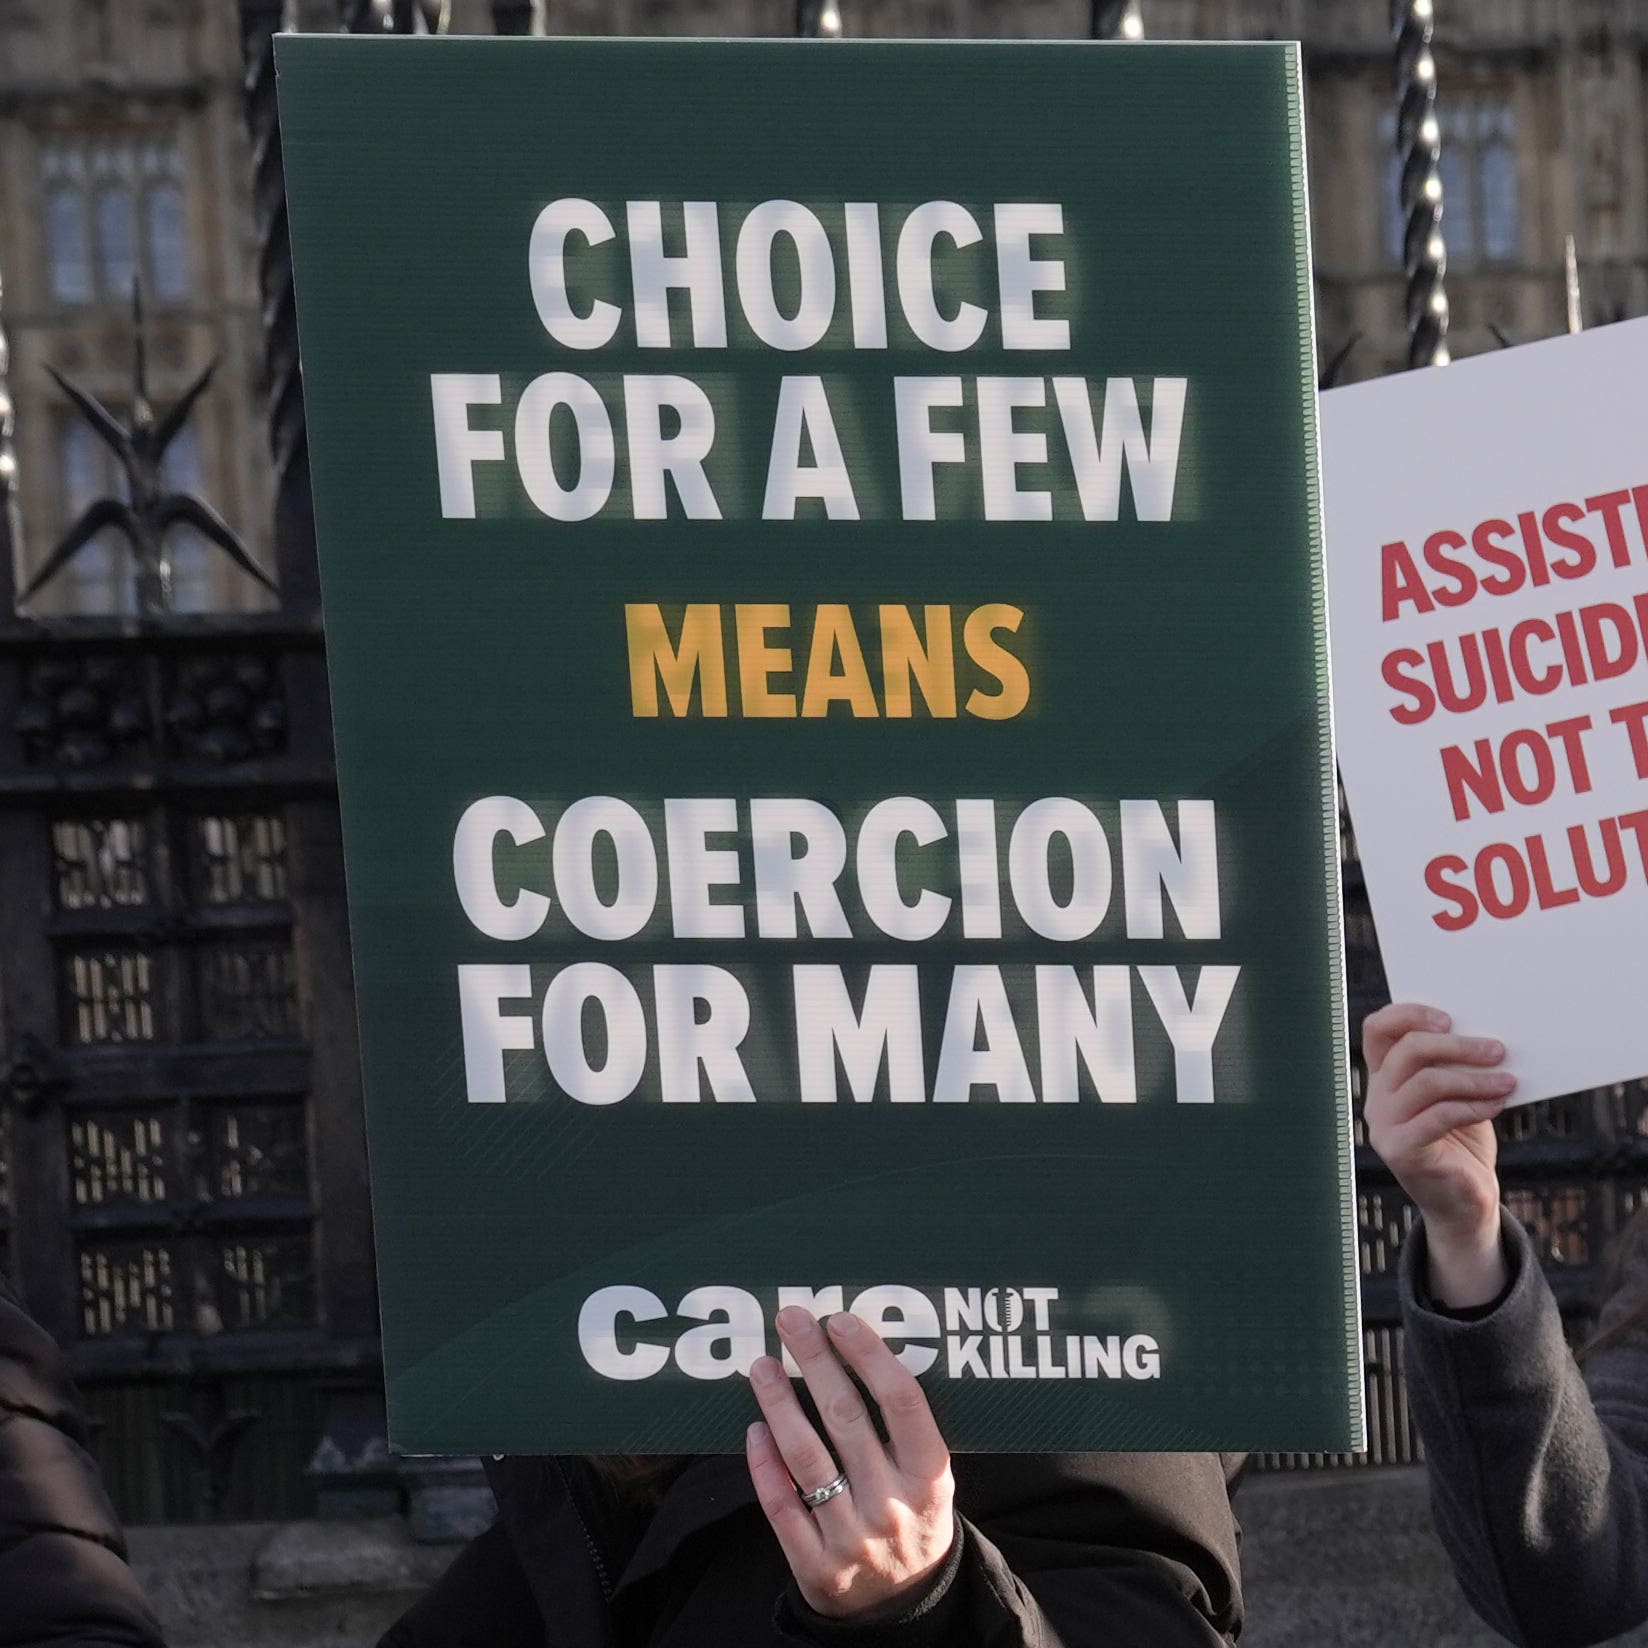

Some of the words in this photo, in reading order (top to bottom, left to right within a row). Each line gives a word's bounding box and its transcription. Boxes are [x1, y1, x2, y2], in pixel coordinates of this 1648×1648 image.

[529, 198, 1070, 351] CHOICE
[431, 372, 722, 521] FOR
[762, 376, 860, 520] A
[894, 377, 1187, 521] FEW
[627, 604, 1029, 719] MEANS
[1442, 716, 1591, 820] NOT
[454, 796, 1220, 941] COERCION
[458, 962, 756, 1105] FOR
[793, 965, 1241, 1103] MANY
[944, 1288, 1058, 1332] NOT
[947, 1335, 1160, 1379] KILLING
